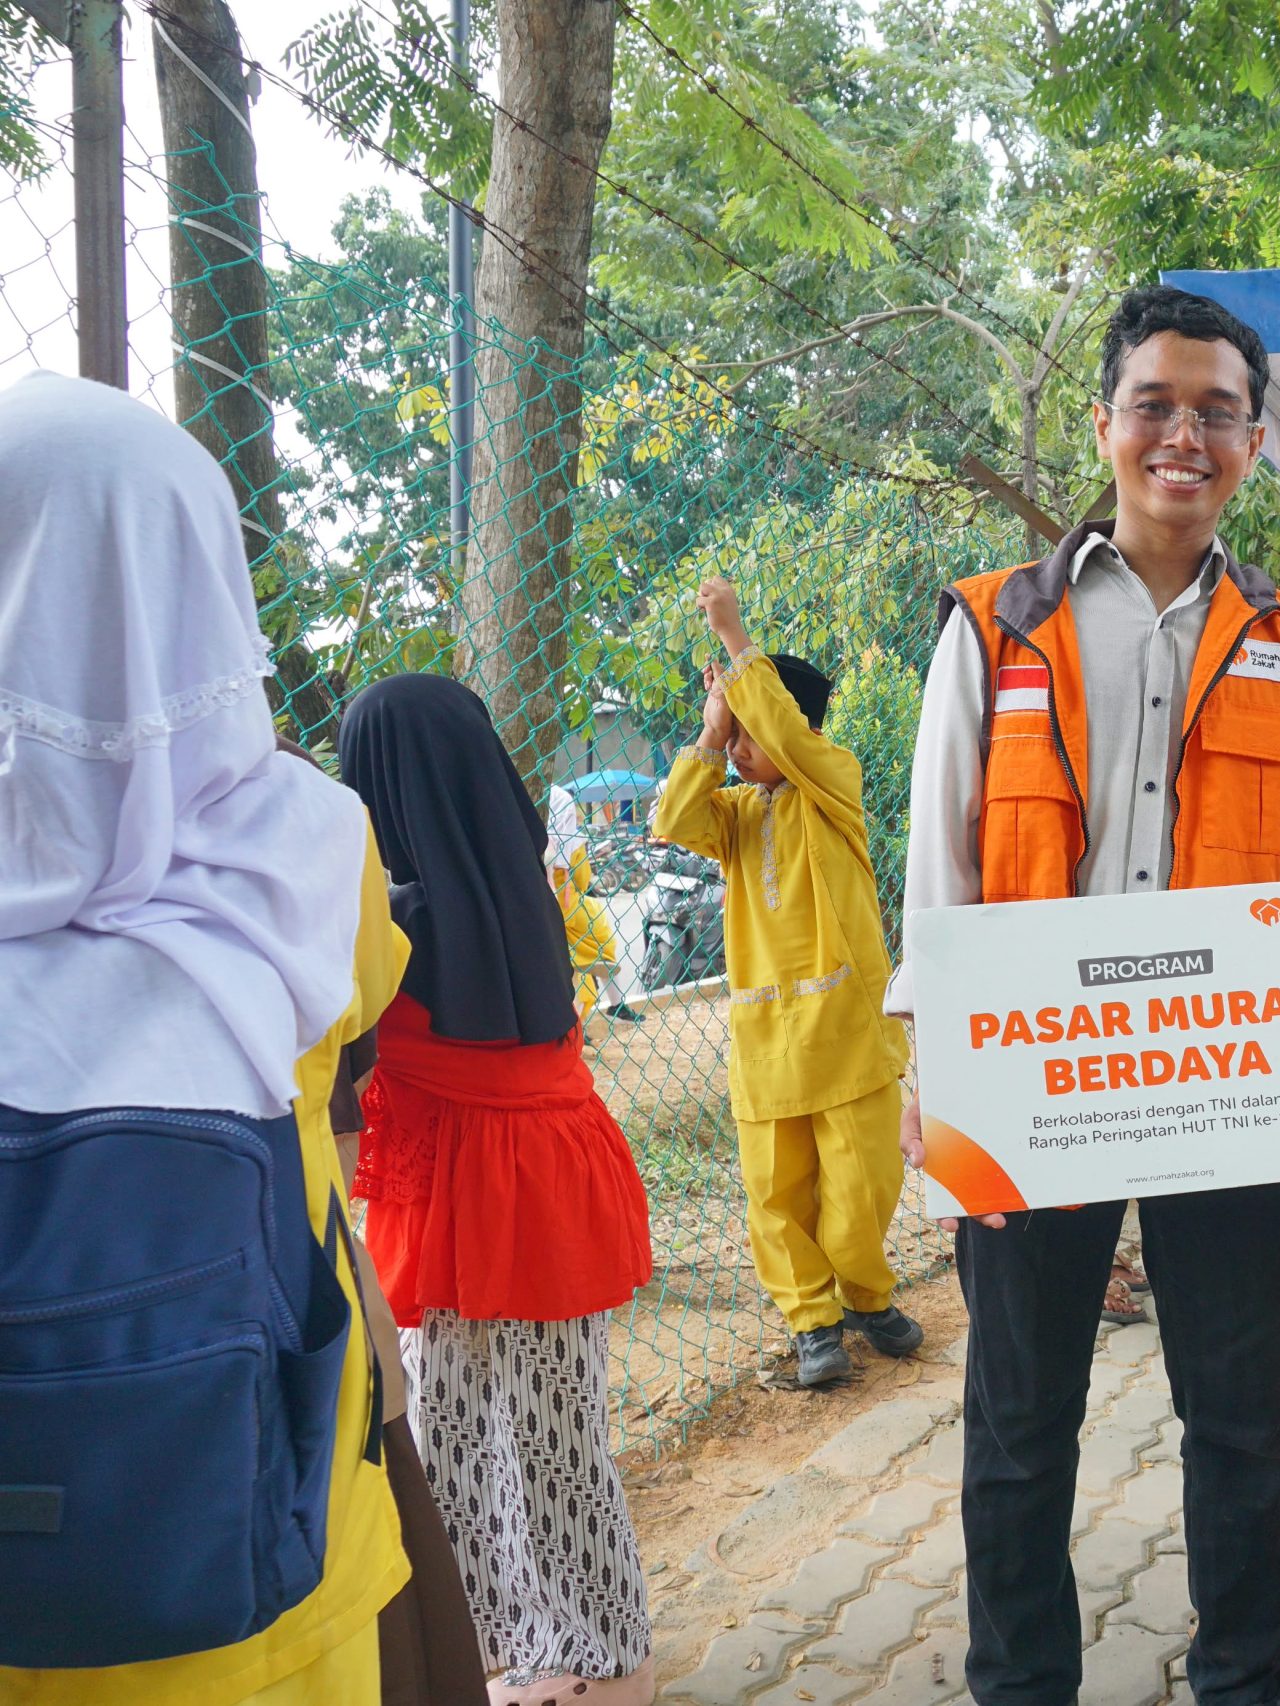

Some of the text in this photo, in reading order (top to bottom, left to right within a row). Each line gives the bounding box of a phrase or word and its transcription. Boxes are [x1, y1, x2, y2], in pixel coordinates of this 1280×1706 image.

[1250, 650, 1280, 661] Rumah
[1252, 658, 1275, 669] Zakat
[1088, 955, 1205, 981] PROGRAM
[969, 1001, 1133, 1049] PASAR
[1044, 1040, 1272, 1095] BERDAYA
[1033, 1106, 1141, 1129] Berkolaborasi
[1146, 1102, 1205, 1119] dengan
[1208, 1097, 1236, 1112] TNI
[1029, 1129, 1087, 1149] Rangka
[1093, 1125, 1178, 1144] Peringatan
[1182, 1119, 1216, 1135] HUT
[1221, 1116, 1249, 1130] TNI
[1126, 1168, 1215, 1184] www.rumahzakat.org
